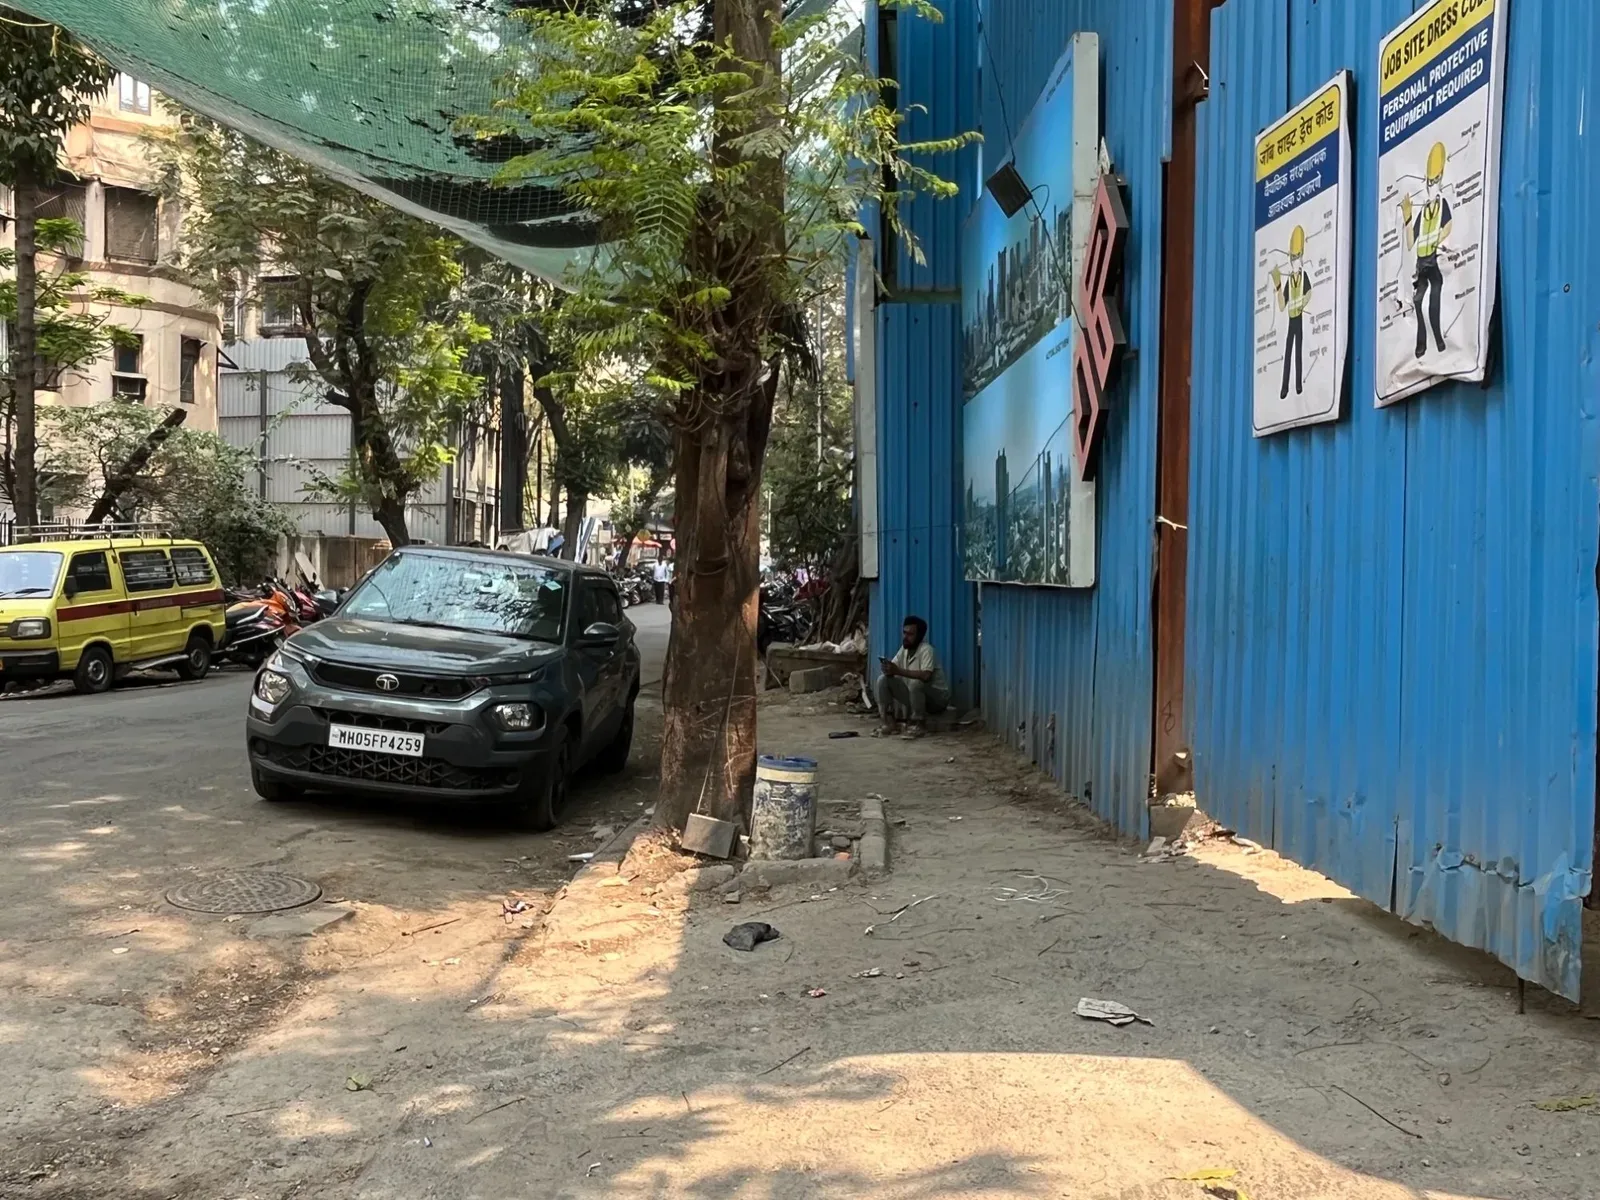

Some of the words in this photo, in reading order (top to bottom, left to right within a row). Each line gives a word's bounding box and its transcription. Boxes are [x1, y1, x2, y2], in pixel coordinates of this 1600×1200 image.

[1383, 76, 1428, 120] PERSONAL
[1429, 28, 1488, 87] PROTECTIVE
[1384, 46, 1401, 80] JOB
[1403, 29, 1425, 65] SITE
[1427, 1, 1458, 47] DRESS
[1259, 142, 1275, 165] जॉब
[1277, 128, 1297, 155] साइट
[1299, 116, 1314, 144] ड्रेस
[1315, 101, 1335, 128] कोड
[1384, 94, 1434, 142] EQUIPMENT
[1435, 58, 1483, 107] REQUIRED
[339, 729, 421, 752] MH05FP4259
